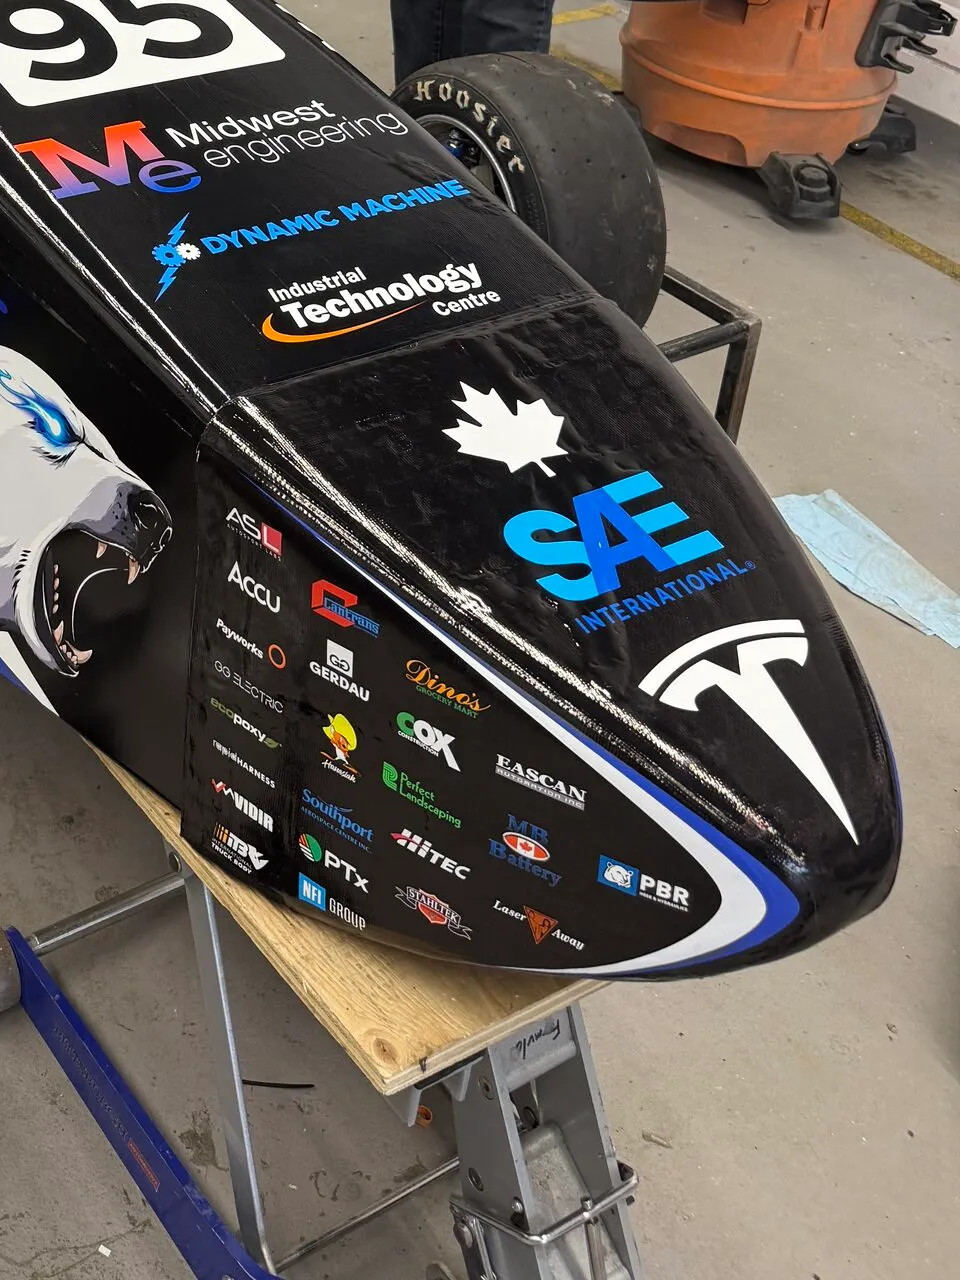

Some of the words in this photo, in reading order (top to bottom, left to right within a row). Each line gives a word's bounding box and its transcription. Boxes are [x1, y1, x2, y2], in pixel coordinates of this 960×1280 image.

[165, 99, 336, 148] Midwest
[203, 110, 409, 169] engineering
[200, 209, 340, 256] DYNAMIC
[337, 178, 471, 223] MACHINE
[267, 266, 367, 303] Industrial
[280, 262, 482, 329] Technology
[432, 290, 501, 317] Centre
[225, 507, 281, 554] ASL
[503, 470, 725, 602] SAE
[227, 560, 281, 613] ACCU
[216, 618, 264, 659] Payworks
[214, 660, 231, 678] GG
[232, 671, 284, 714] ELECTRIC
[309, 660, 370, 702] GERDAU
[405, 660, 492, 711] Dino's
[415, 685, 453, 707] GROCERY
[453, 702, 479, 719] MART
[210, 697, 267, 743] ecopoxy
[396, 712, 461, 773] COX
[397, 730, 440, 758] CONSTRUCTION
[399, 771, 435, 802] Perfect
[495, 753, 588, 803] EASCAN
[496, 767, 561, 802] AUTOMATION
[233, 790, 274, 833] VIDIR
[300, 806, 336, 832] AEROSPACE
[334, 826, 358, 846] CENTRE
[302, 788, 375, 843] Southport
[399, 782, 462, 829] Landscaping
[507, 813, 549, 846] MB
[211, 840, 233, 862] TRUCK
[233, 858, 253, 875] BODY
[488, 838, 562, 887] Battery
[302, 879, 322, 905] NFI
[329, 897, 366, 931] GROUP
[408, 888, 458, 924] STAHLTEK
[492, 899, 527, 922] Laser
[639, 873, 690, 907] PBR
[551, 927, 585, 951] Away
